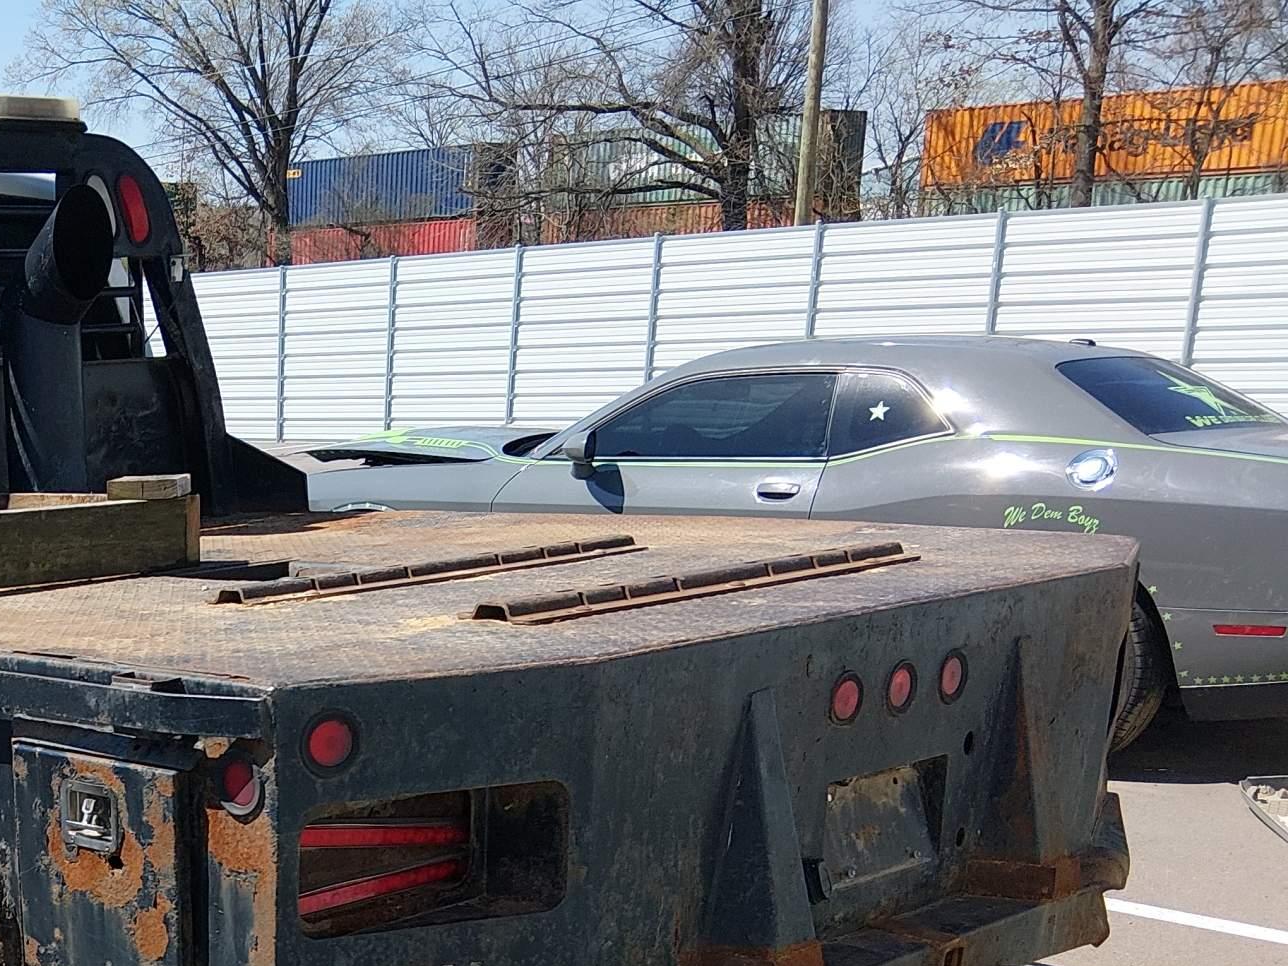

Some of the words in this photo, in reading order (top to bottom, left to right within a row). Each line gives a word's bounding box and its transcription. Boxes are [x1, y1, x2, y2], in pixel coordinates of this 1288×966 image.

[1003, 506, 1027, 529] We
[1031, 502, 1063, 520] Dem
[1067, 505, 1100, 536] Boyz
